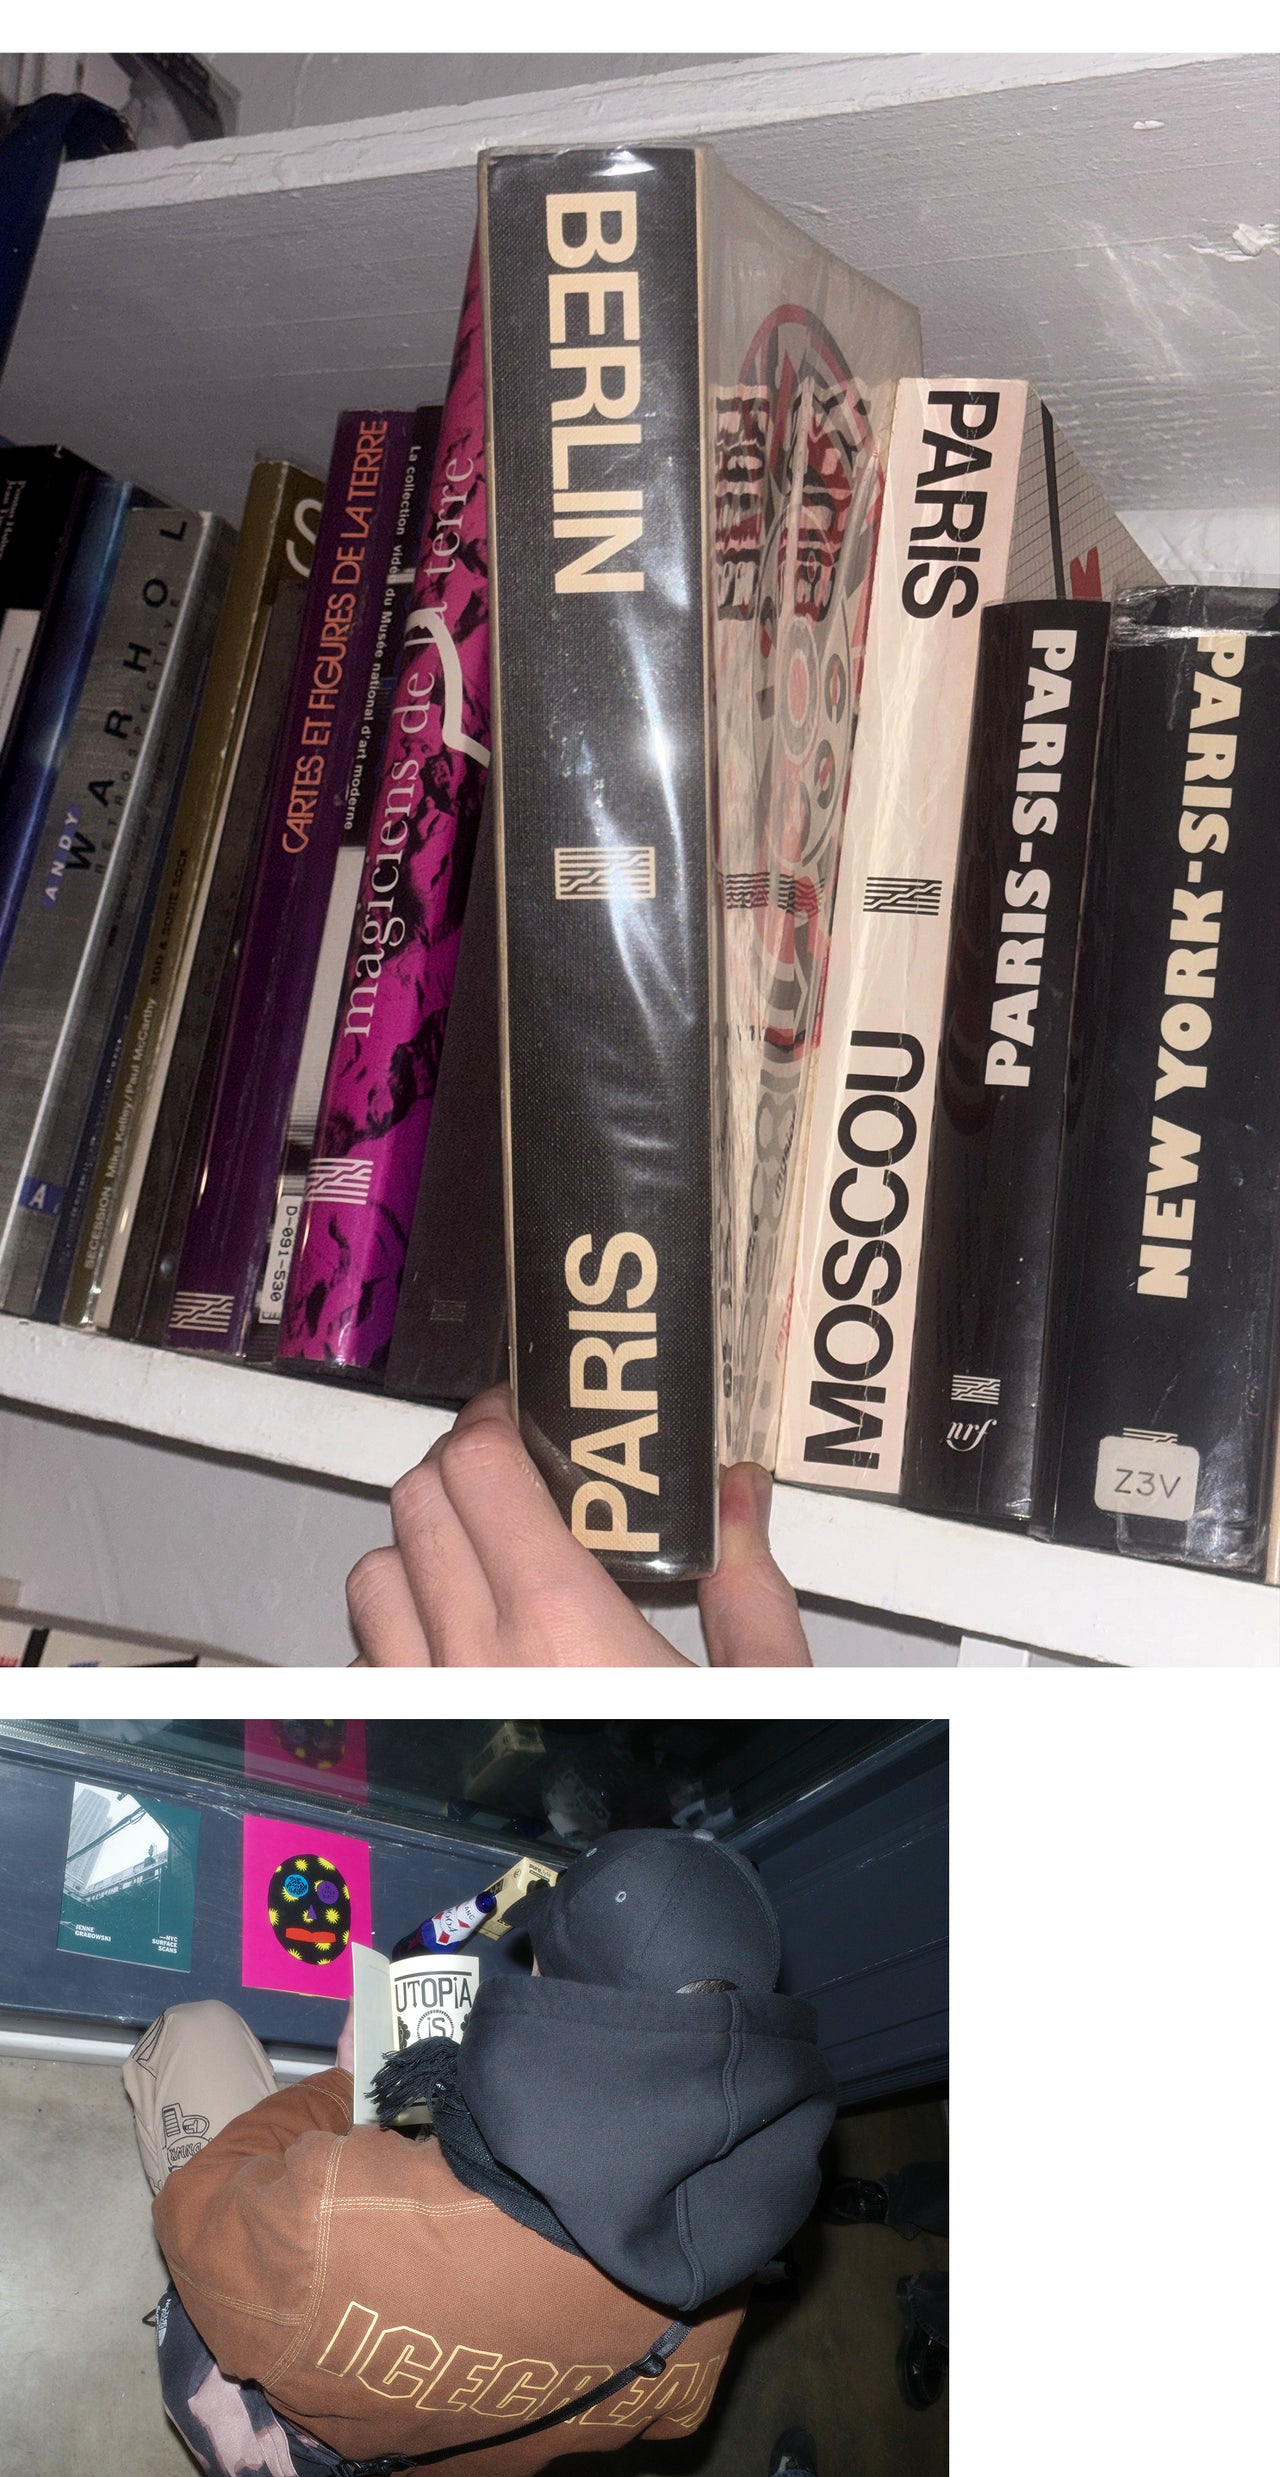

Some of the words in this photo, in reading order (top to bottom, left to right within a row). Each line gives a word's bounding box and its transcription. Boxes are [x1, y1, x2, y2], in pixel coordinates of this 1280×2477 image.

[546, 191, 645, 594] BERLIN
[347, 420, 388, 501] TERRE
[408, 446, 421, 462] La
[340, 506, 373, 538] LA
[396, 466, 415, 536] collection
[901, 391, 1000, 619] PARIS
[332, 547, 365, 584] DE
[384, 588, 396, 606] du
[308, 592, 356, 710] FIGURES
[374, 610, 393, 658] Musée
[65, 521, 187, 871] WARHOL
[363, 662, 382, 720] national
[301, 716, 332, 745] ET
[344, 759, 419, 1037] magiciens
[392, 671, 435, 734] de
[424, 458, 474, 577] terre
[356, 726, 371, 760] d'art
[282, 755, 325, 853] CARTES
[344, 765, 363, 830] moderne
[45, 811, 79, 901] ANDY
[84, 1186, 112, 1269] SECESSION
[134, 997, 157, 1061] McCarthy
[1136, 1116, 1202, 1299] NEW
[270, 1205, 298, 1302] D-091-530
[803, 1029, 925, 1470] MOSCOU
[564, 1231, 660, 1552] PARIS
[1115, 1467, 1181, 1499] Z3V
[74, 1930, 112, 1942] GRABOWSKI
[151, 1938, 178, 1949] SURFACE
[158, 1945, 178, 1954] SCANS
